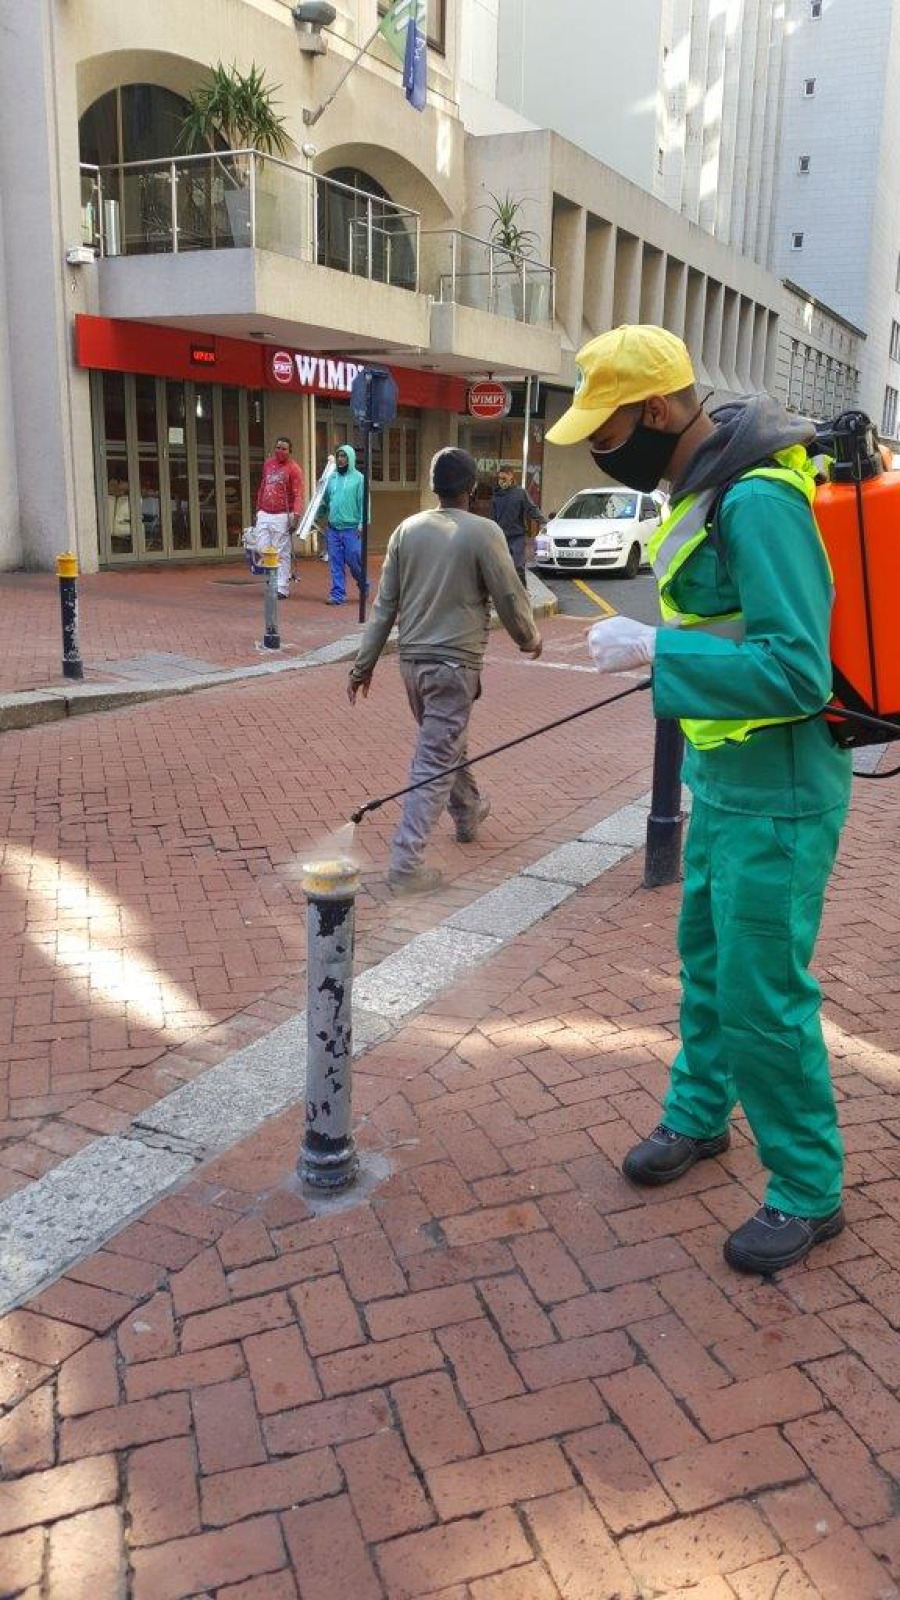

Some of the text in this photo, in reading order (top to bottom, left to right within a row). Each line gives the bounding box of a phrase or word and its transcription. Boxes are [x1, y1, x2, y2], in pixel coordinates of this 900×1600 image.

[294, 354, 364, 392] WIMP
[471, 393, 504, 404] WIMPY
[475, 458, 504, 472] MPY
